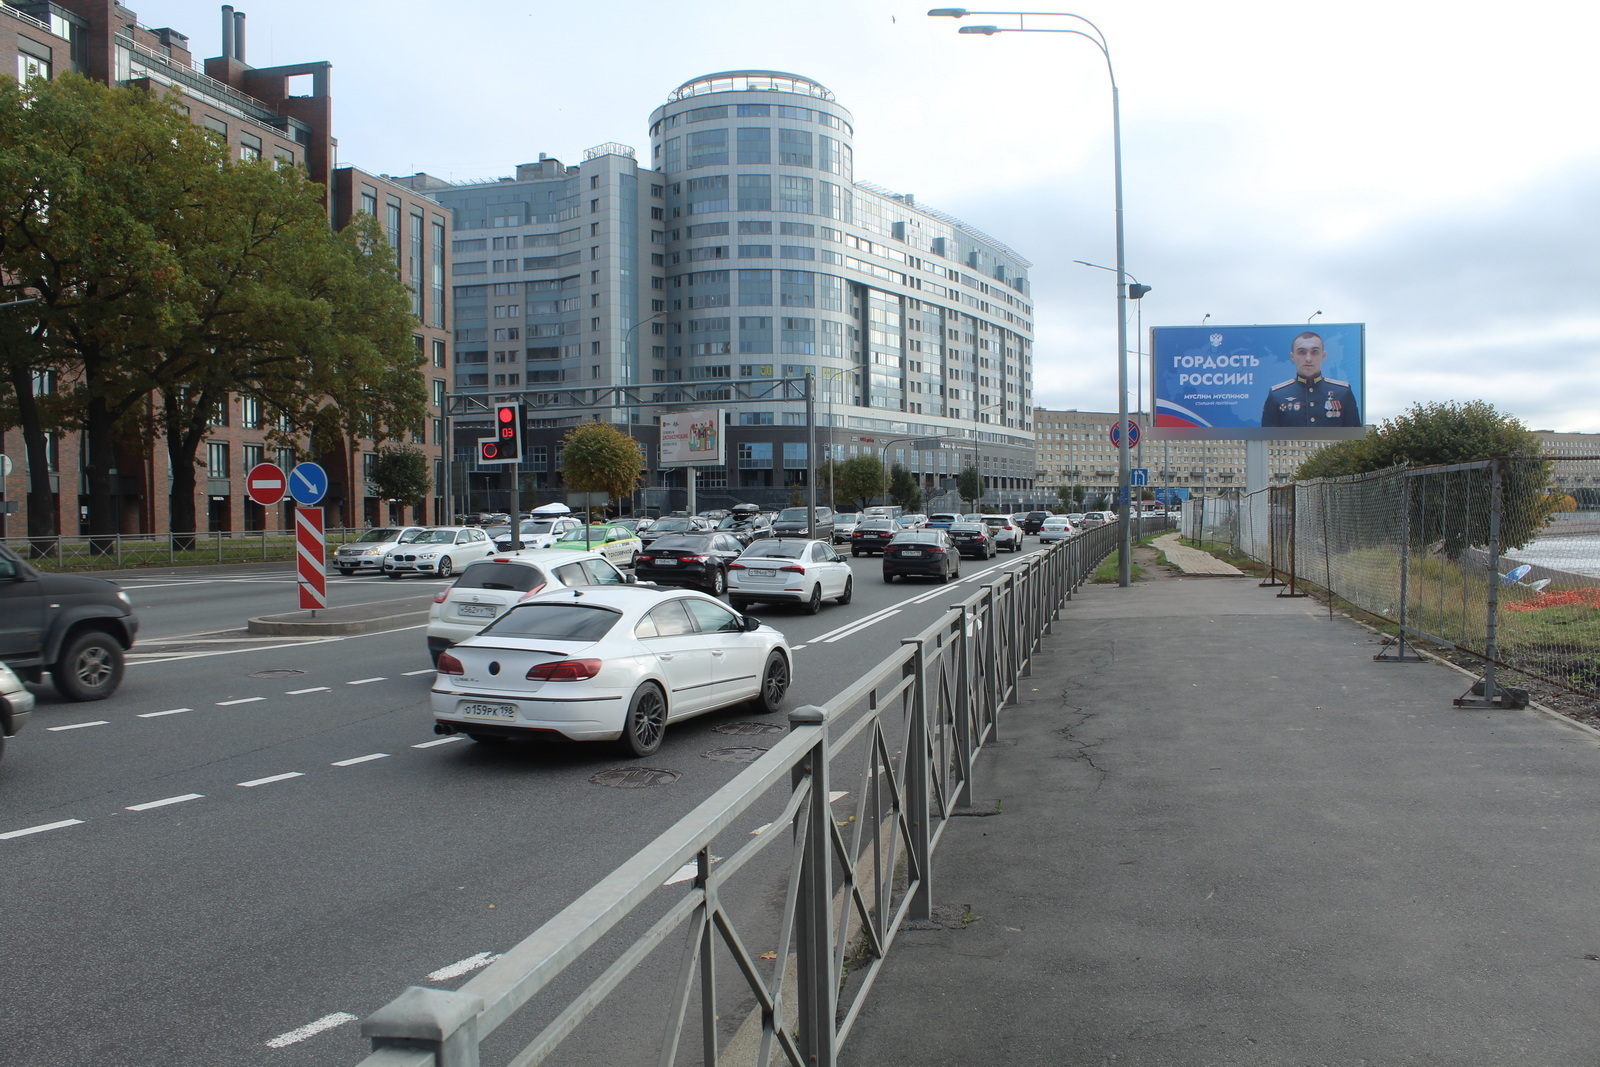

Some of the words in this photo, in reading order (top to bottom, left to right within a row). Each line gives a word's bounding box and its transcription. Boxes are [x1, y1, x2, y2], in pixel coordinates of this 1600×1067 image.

[1173, 355, 1260, 369] ГОРДОСТЬ
[1179, 372, 1254, 386] РОССИИ!
[502, 428, 513, 437] 03
[465, 704, 498, 716] О159РК
[500, 706, 513, 714] 198
